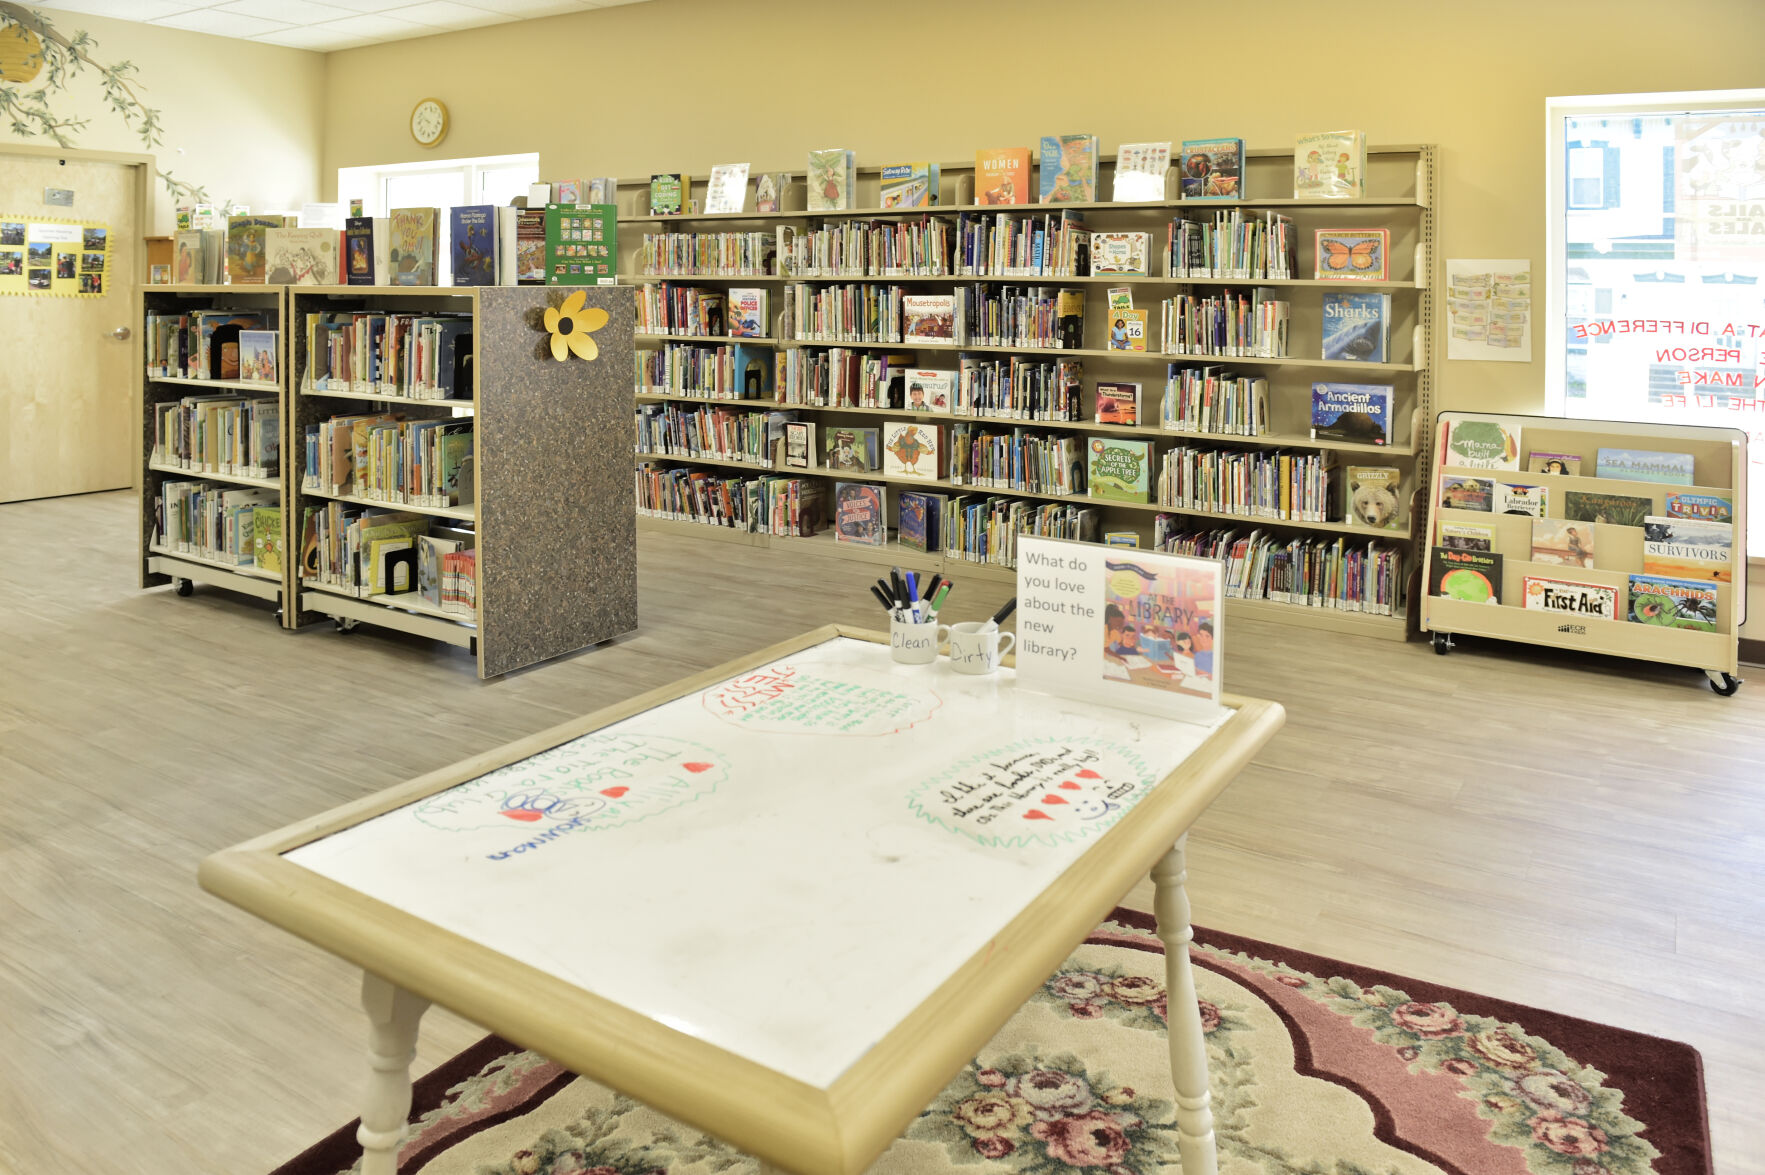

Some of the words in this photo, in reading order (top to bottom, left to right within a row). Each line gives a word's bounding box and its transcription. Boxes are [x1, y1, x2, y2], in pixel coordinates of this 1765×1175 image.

[983, 158, 1019, 171] WOMEN
[394, 210, 424, 227] THANK
[906, 297, 951, 308] Mousetropolis
[1113, 310, 1120, 319] A
[1122, 310, 1139, 320] Day
[1325, 303, 1380, 319] Sharks
[1129, 327, 1141, 337] 16
[1327, 391, 1371, 403] Ancient
[1318, 401, 1381, 414] Armadillos
[1455, 440, 1503, 449] Mama
[1104, 453, 1132, 464] SECRETS
[1467, 449, 1490, 458] built
[1100, 466, 1121, 475] APPLE
[1121, 468, 1137, 477] TREE
[1605, 458, 1627, 468] SEA
[1631, 461, 1686, 472] MAMMAL
[1356, 472, 1390, 480] GRIZZLY
[846, 499, 867, 509] VOICES
[1504, 495, 1539, 506] Labrador
[1681, 496, 1718, 506] OLYMPIC
[847, 511, 868, 521] JUSTICE
[1672, 503, 1729, 517] TRIVIA
[255, 516, 280, 529] CHICKE
[1648, 544, 1728, 562] SURVIVORS
[1025, 551, 1065, 569] What
[1068, 557, 1087, 572] do
[1024, 576, 1051, 588] you
[1055, 577, 1086, 594] love
[1633, 582, 1715, 601] ARACHNIDS
[1161, 594, 1175, 605] THE
[1543, 587, 1576, 611] First
[1578, 592, 1604, 615] Aid
[1024, 596, 1066, 614] about
[1070, 603, 1095, 618] the
[1129, 599, 1195, 626] LIBRARY
[1024, 620, 1054, 634] new
[892, 631, 930, 649] Clean
[952, 641, 992, 669] Dirty
[1023, 639, 1077, 662] library?
